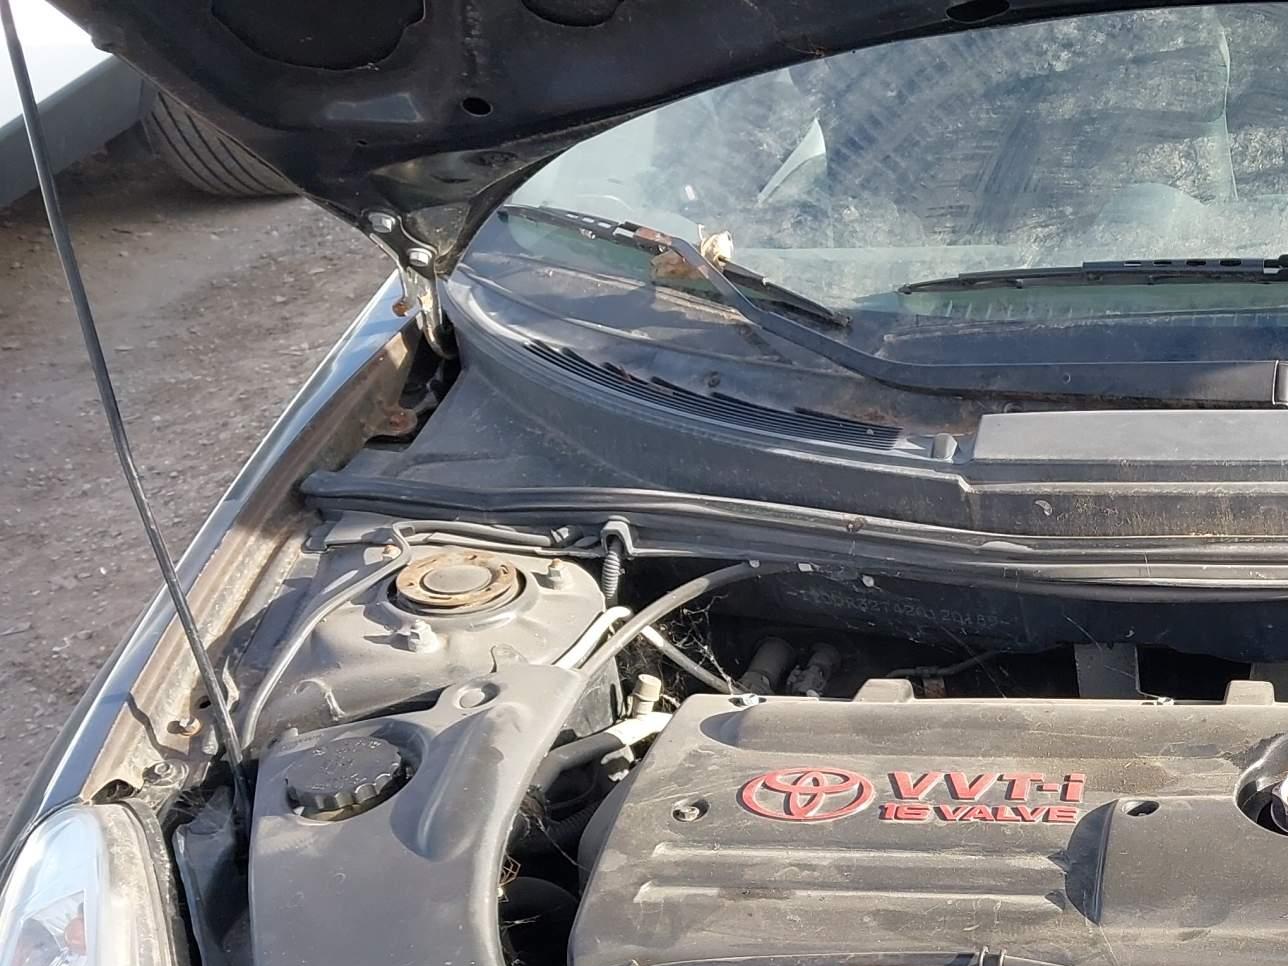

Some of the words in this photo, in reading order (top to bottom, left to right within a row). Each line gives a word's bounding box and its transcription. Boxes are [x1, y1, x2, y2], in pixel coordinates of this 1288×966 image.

[887, 771, 1087, 802] VVT-i
[879, 802, 932, 823] 16
[934, 803, 1081, 824] VALVE
